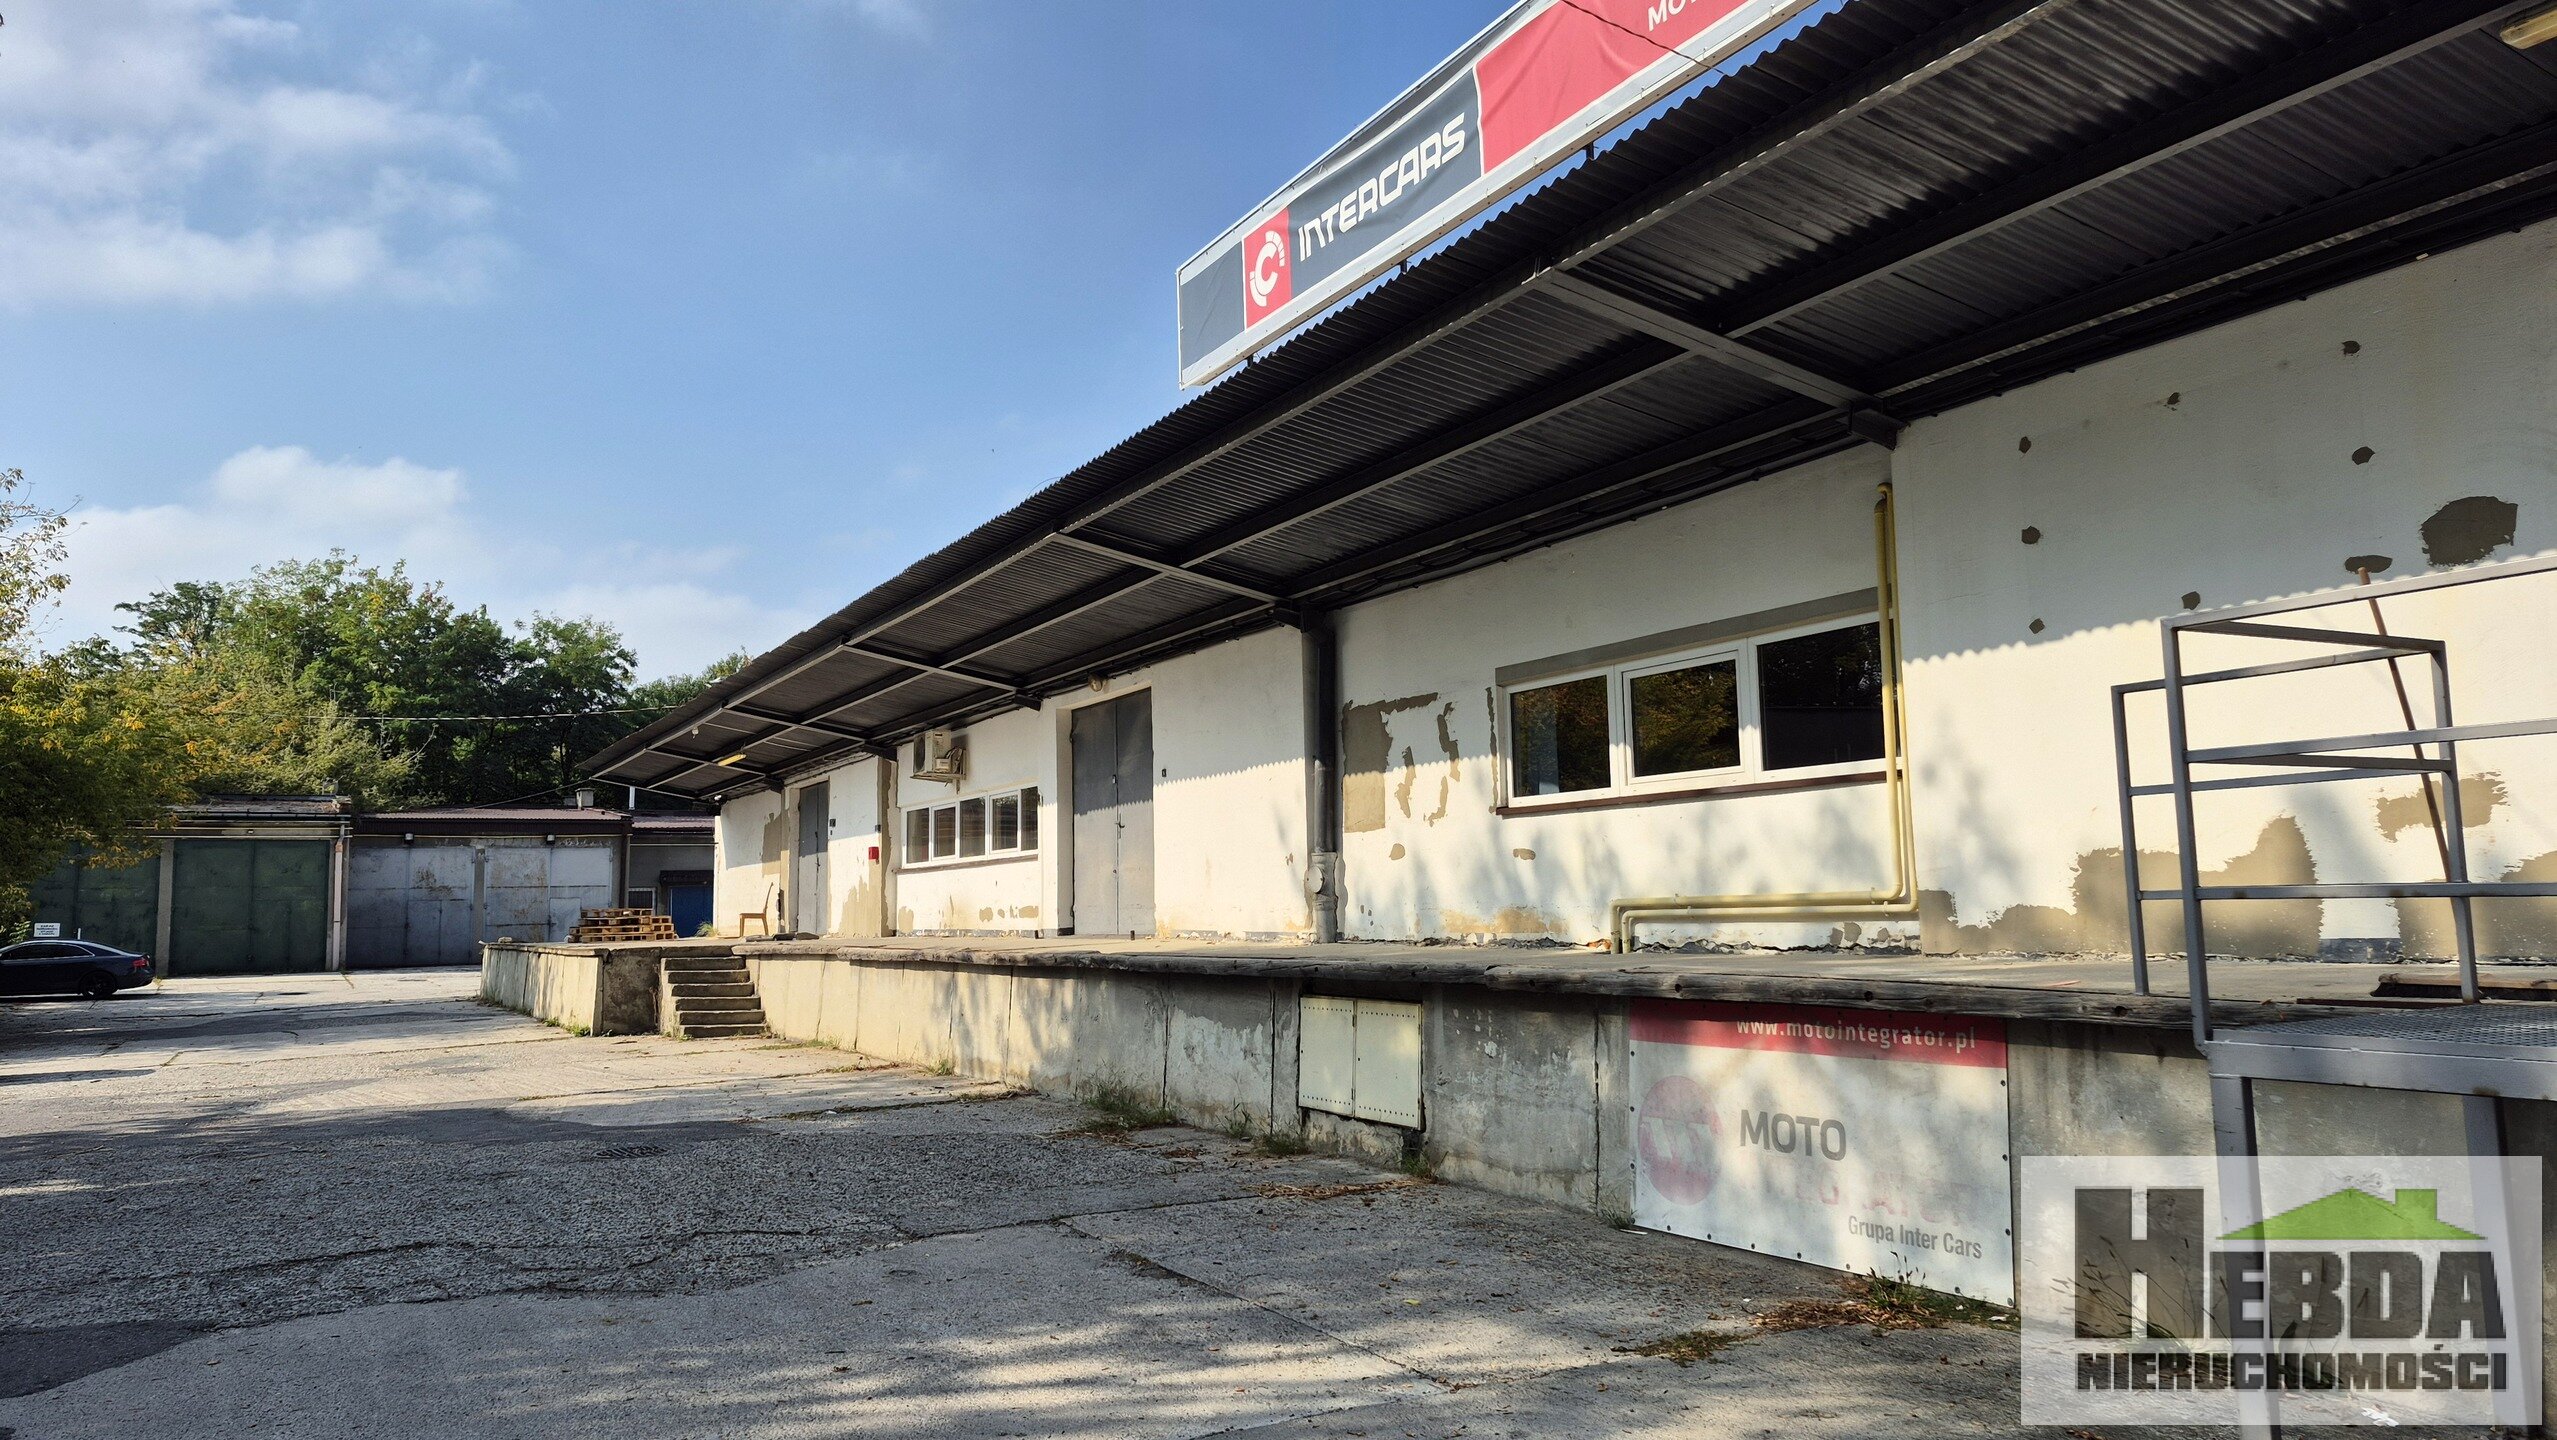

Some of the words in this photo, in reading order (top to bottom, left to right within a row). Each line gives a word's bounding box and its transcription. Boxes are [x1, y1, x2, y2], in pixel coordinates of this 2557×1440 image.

[1648, 0, 1697, 32] MO
[1736, 1019, 1976, 1054] www.motointegrator.pl
[1739, 1109, 1847, 1161] MOTO
[1848, 1215, 1894, 1244] Grupa
[1899, 1224, 1938, 1251] Inter
[1942, 1231, 1982, 1260] Cars
